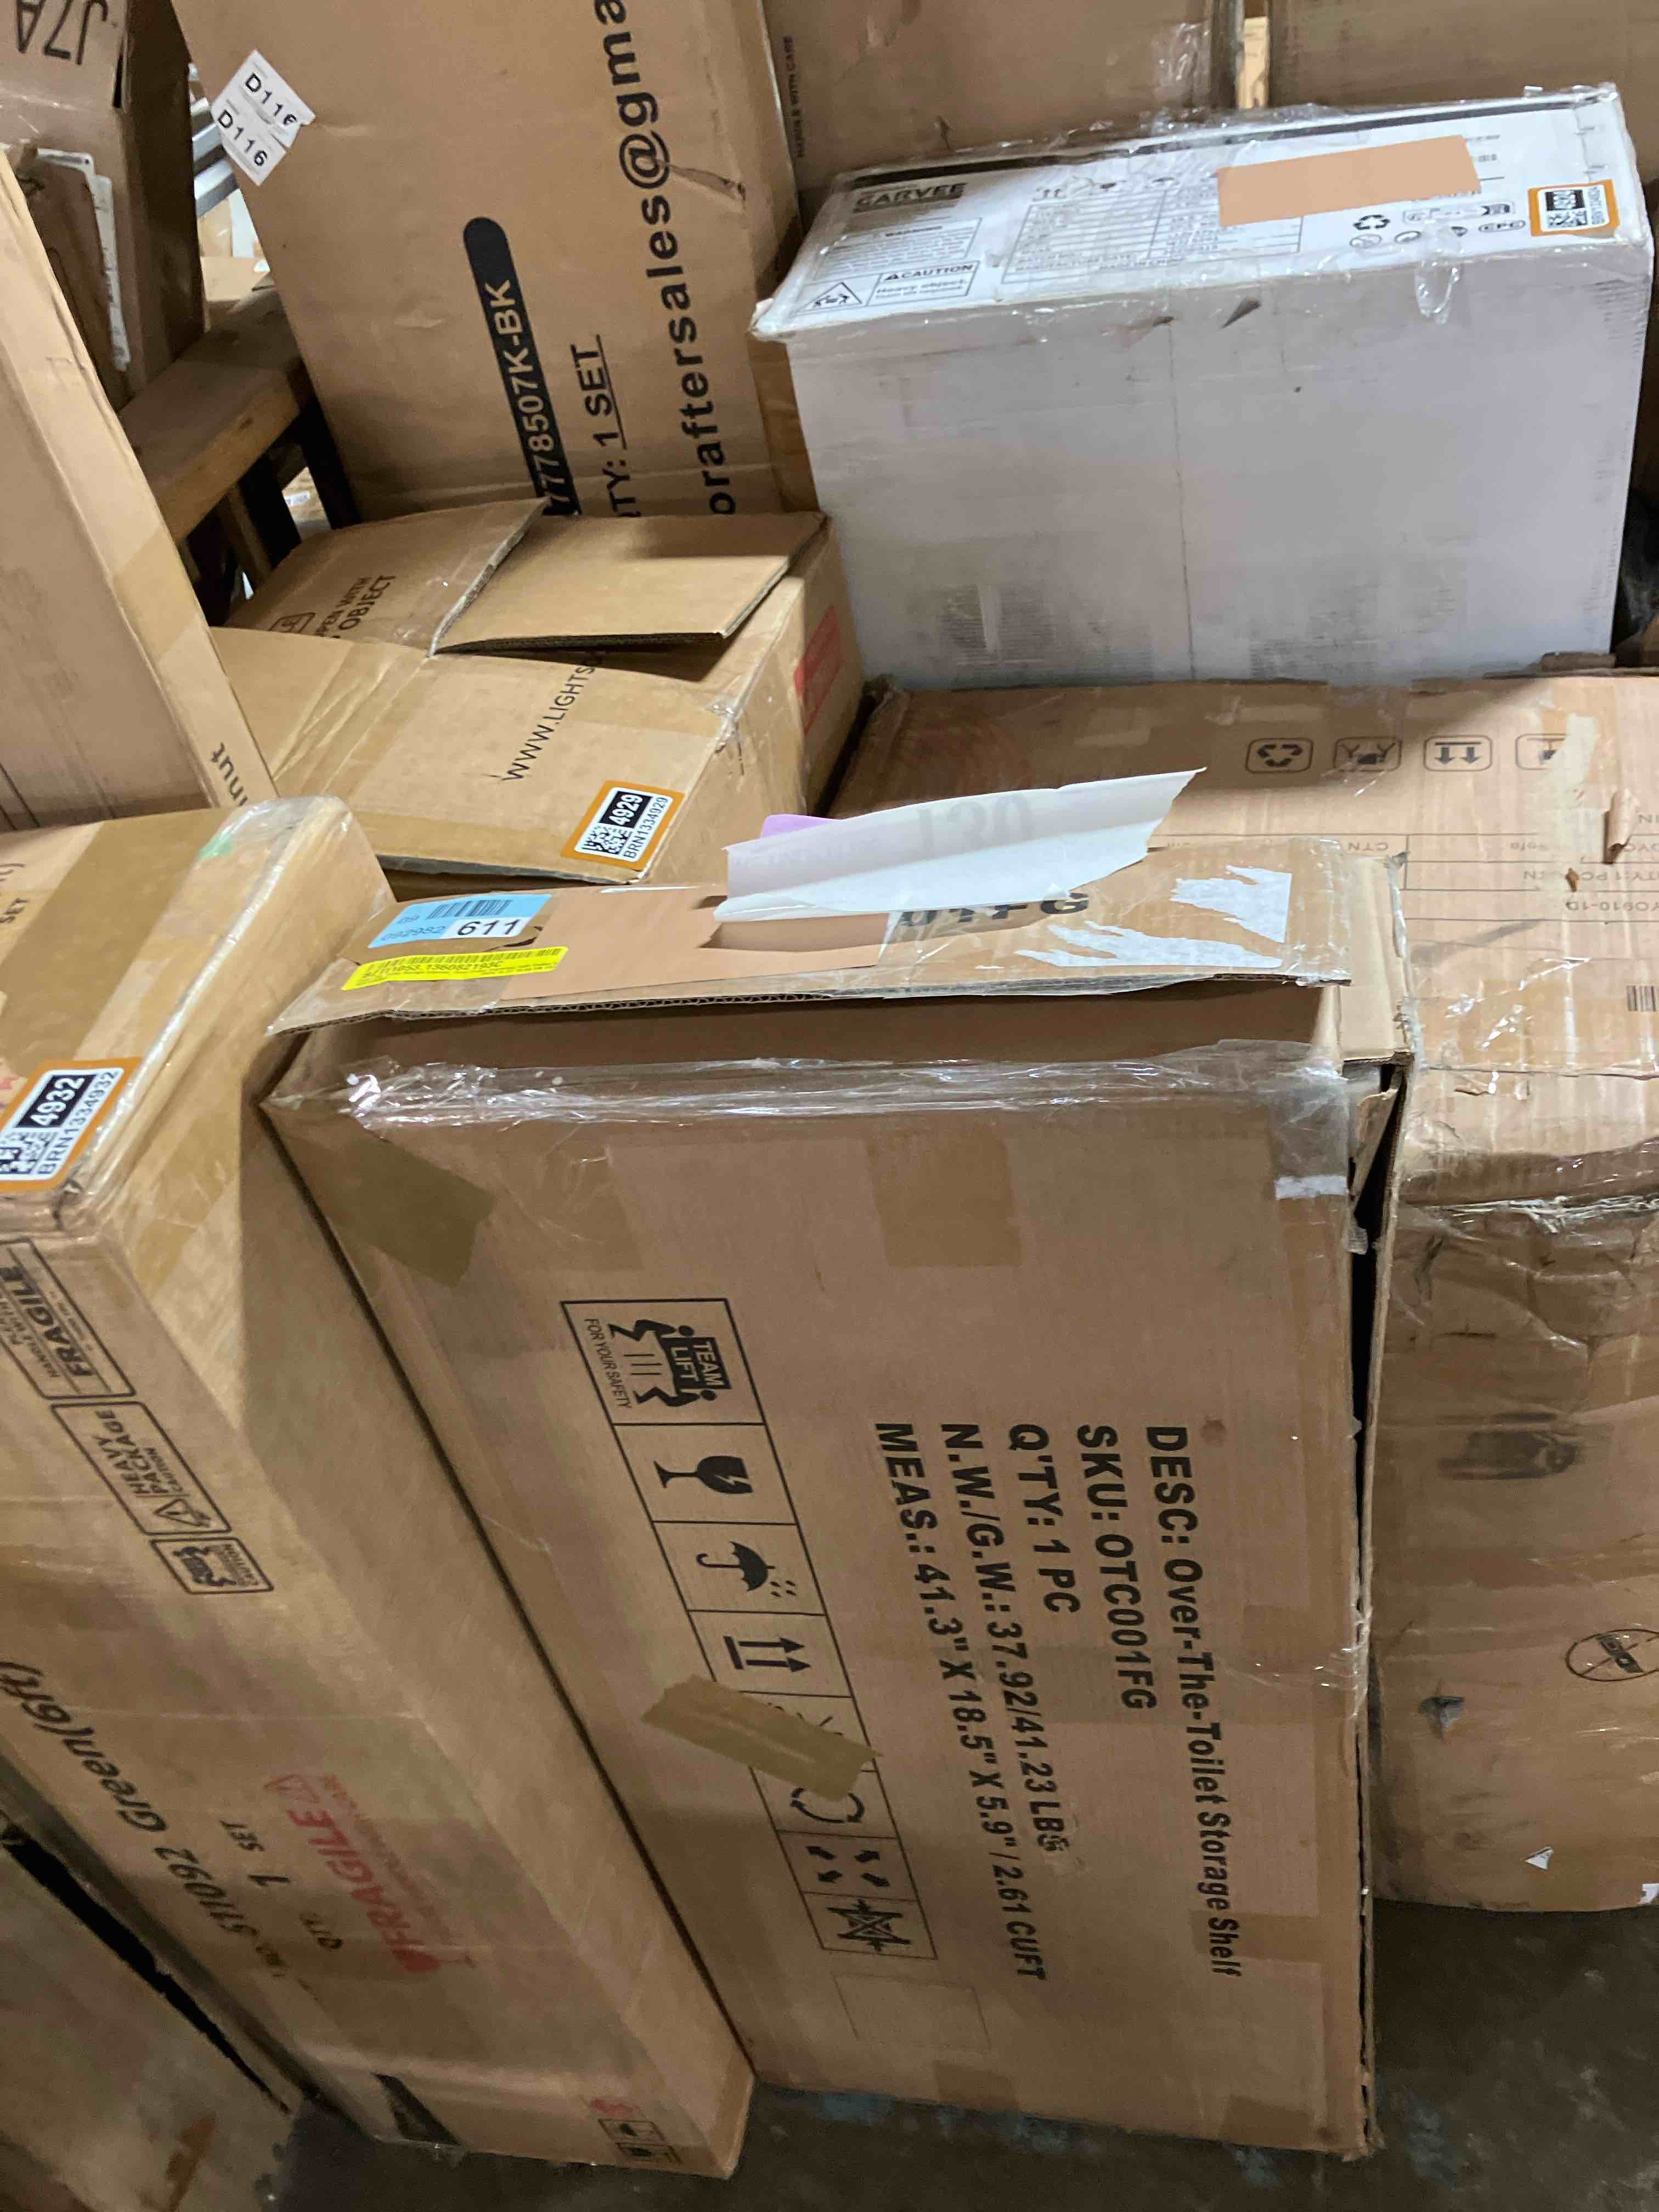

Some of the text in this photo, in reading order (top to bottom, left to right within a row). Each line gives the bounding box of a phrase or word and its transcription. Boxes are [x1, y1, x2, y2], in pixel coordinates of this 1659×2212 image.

[218, 110, 268, 166] D116
[900, 264, 974, 281] CAUTION
[571, 343, 613, 416] SET
[593, 432, 619, 447] 1
[502, 666, 596, 781] WWW.LIGHTS
[610, 794, 644, 826] 4929
[624, 797, 669, 859] BRN1334929
[457, 918, 521, 937] 611
[31, 1077, 85, 1126] 4932
[38, 1071, 119, 1175] BRN1334932
[585, 1319, 632, 1408] FOR YOUR SAFETY
[671, 1347, 697, 1383] LIFT
[693, 1342, 725, 1386] TEAM
[93, 1434, 151, 1495] HEAVY
[95, 1409, 170, 1495] PACKAGE
[1009, 1424, 1080, 1613] Q'TY: 1 PC
[1077, 1425, 1157, 1710] SKU: OTC001FG
[941, 1424, 1017, 1612] N.W./G.W.:
[987, 1621, 1057, 1794] 37.92/41.23
[876, 1423, 1046, 1981] MEAS.: 41.3" X 18.5" X 5.9" / 2.61 CUFT
[1146, 1427, 1242, 1977] DESC: Over-The-Toilet Storage Shelf
[0, 1662, 167, 1832] Green(6ft)
[220, 1819, 266, 1853] SET
[249, 1872, 290, 1888] 1
[289, 1808, 425, 1953] FRAGILE
